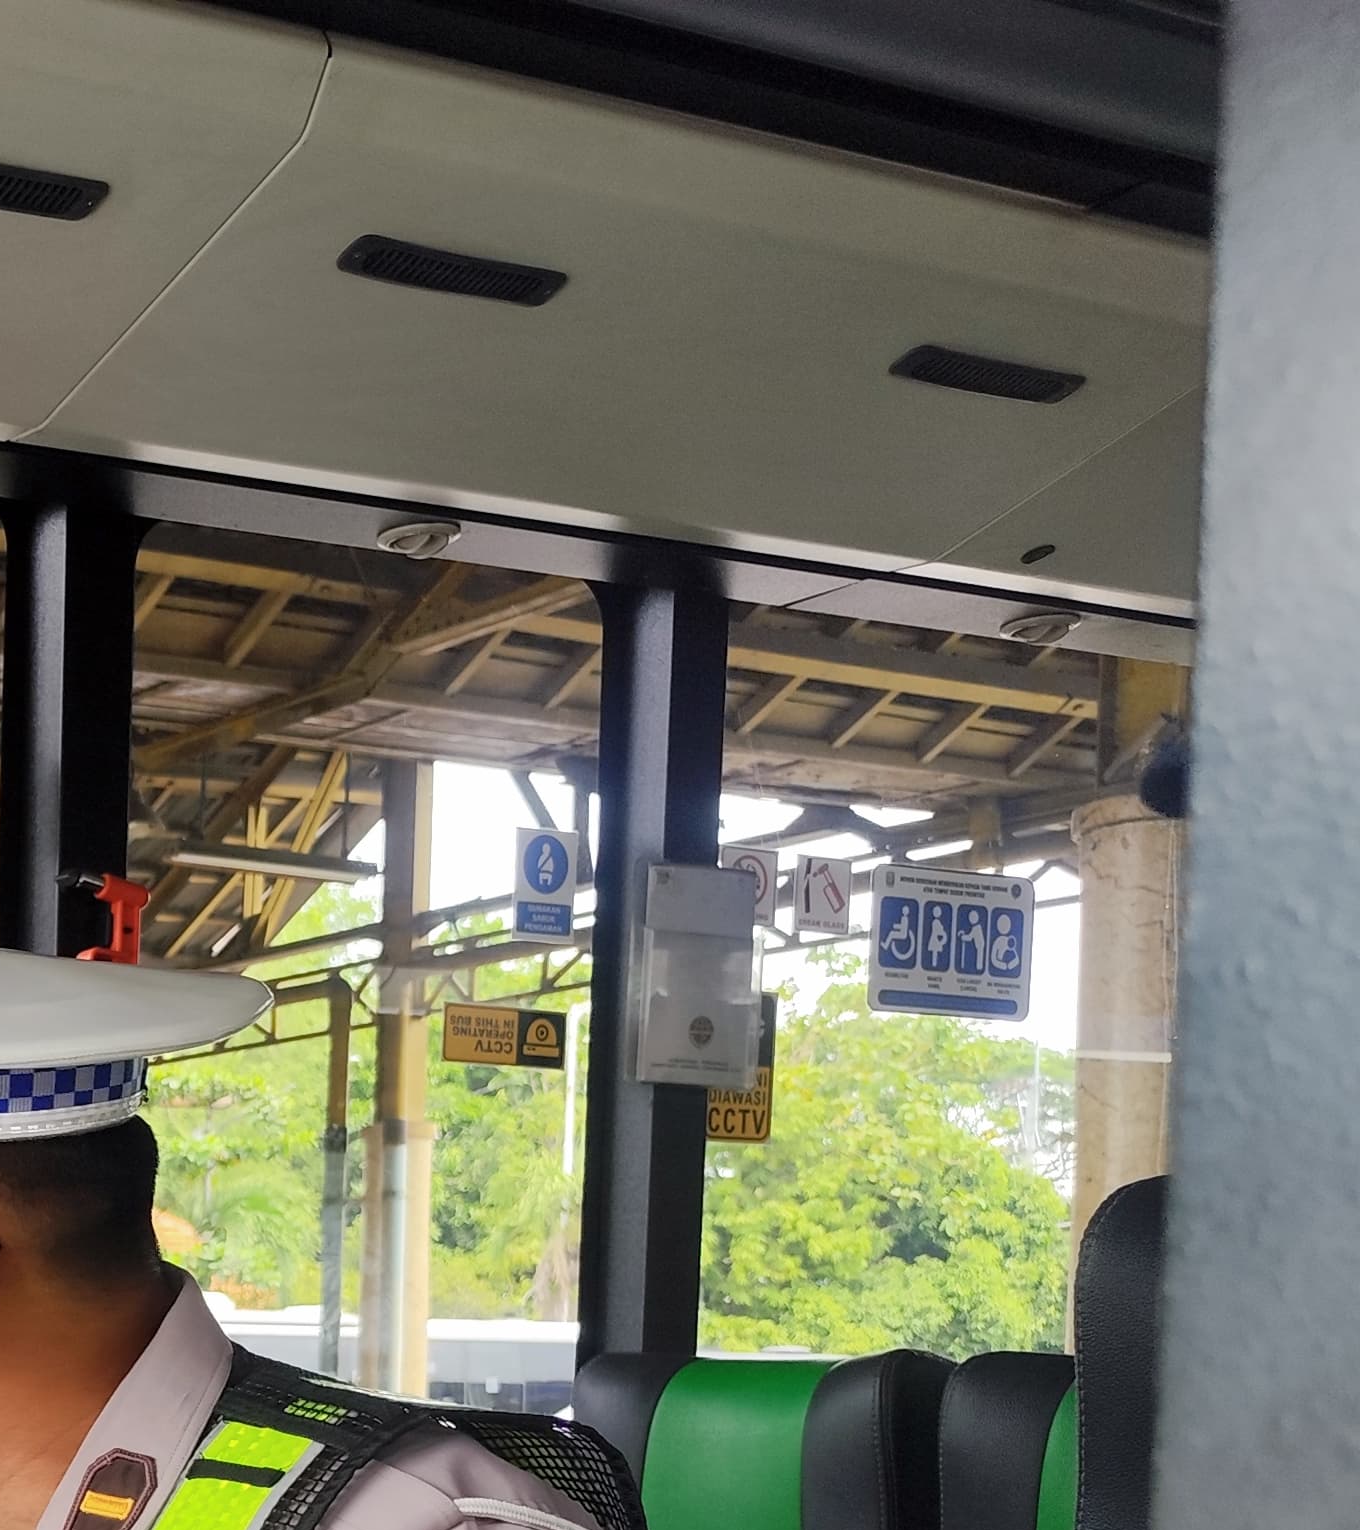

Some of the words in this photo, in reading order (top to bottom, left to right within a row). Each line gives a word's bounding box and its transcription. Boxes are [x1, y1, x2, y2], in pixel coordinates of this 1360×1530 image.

[449, 1014, 472, 1026] BUS
[476, 1016, 500, 1027] THIS
[503, 1019, 515, 1029] IN
[452, 1026, 514, 1040] OPERATING
[474, 1039, 513, 1055] CCTV
[708, 1090, 766, 1106] DIAWASI
[708, 1107, 766, 1135] CCTV
